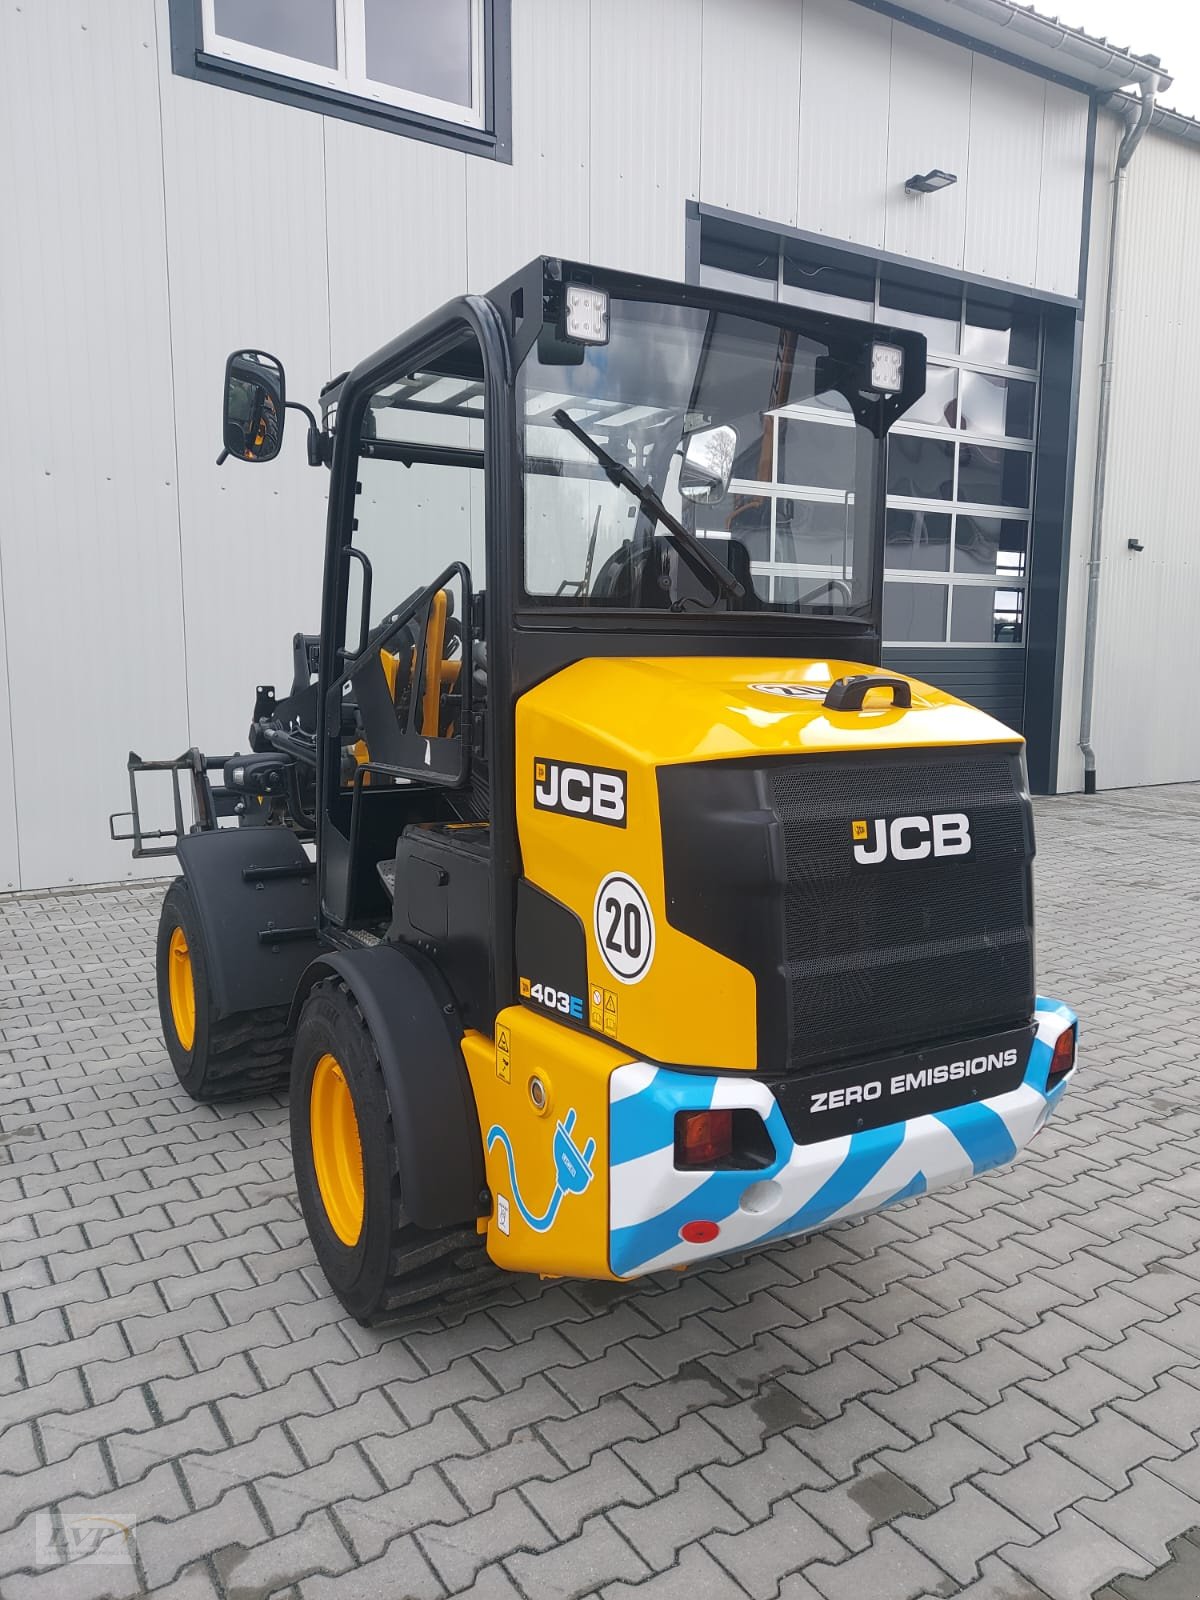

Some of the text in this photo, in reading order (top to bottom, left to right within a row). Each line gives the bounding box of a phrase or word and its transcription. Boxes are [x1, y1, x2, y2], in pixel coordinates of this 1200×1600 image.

[536, 765, 625, 821] JCB
[852, 813, 971, 865] JCB
[605, 897, 642, 959] 20
[531, 983, 583, 1019] 403E
[809, 1048, 1018, 1113] ZERO EMISSIONS
